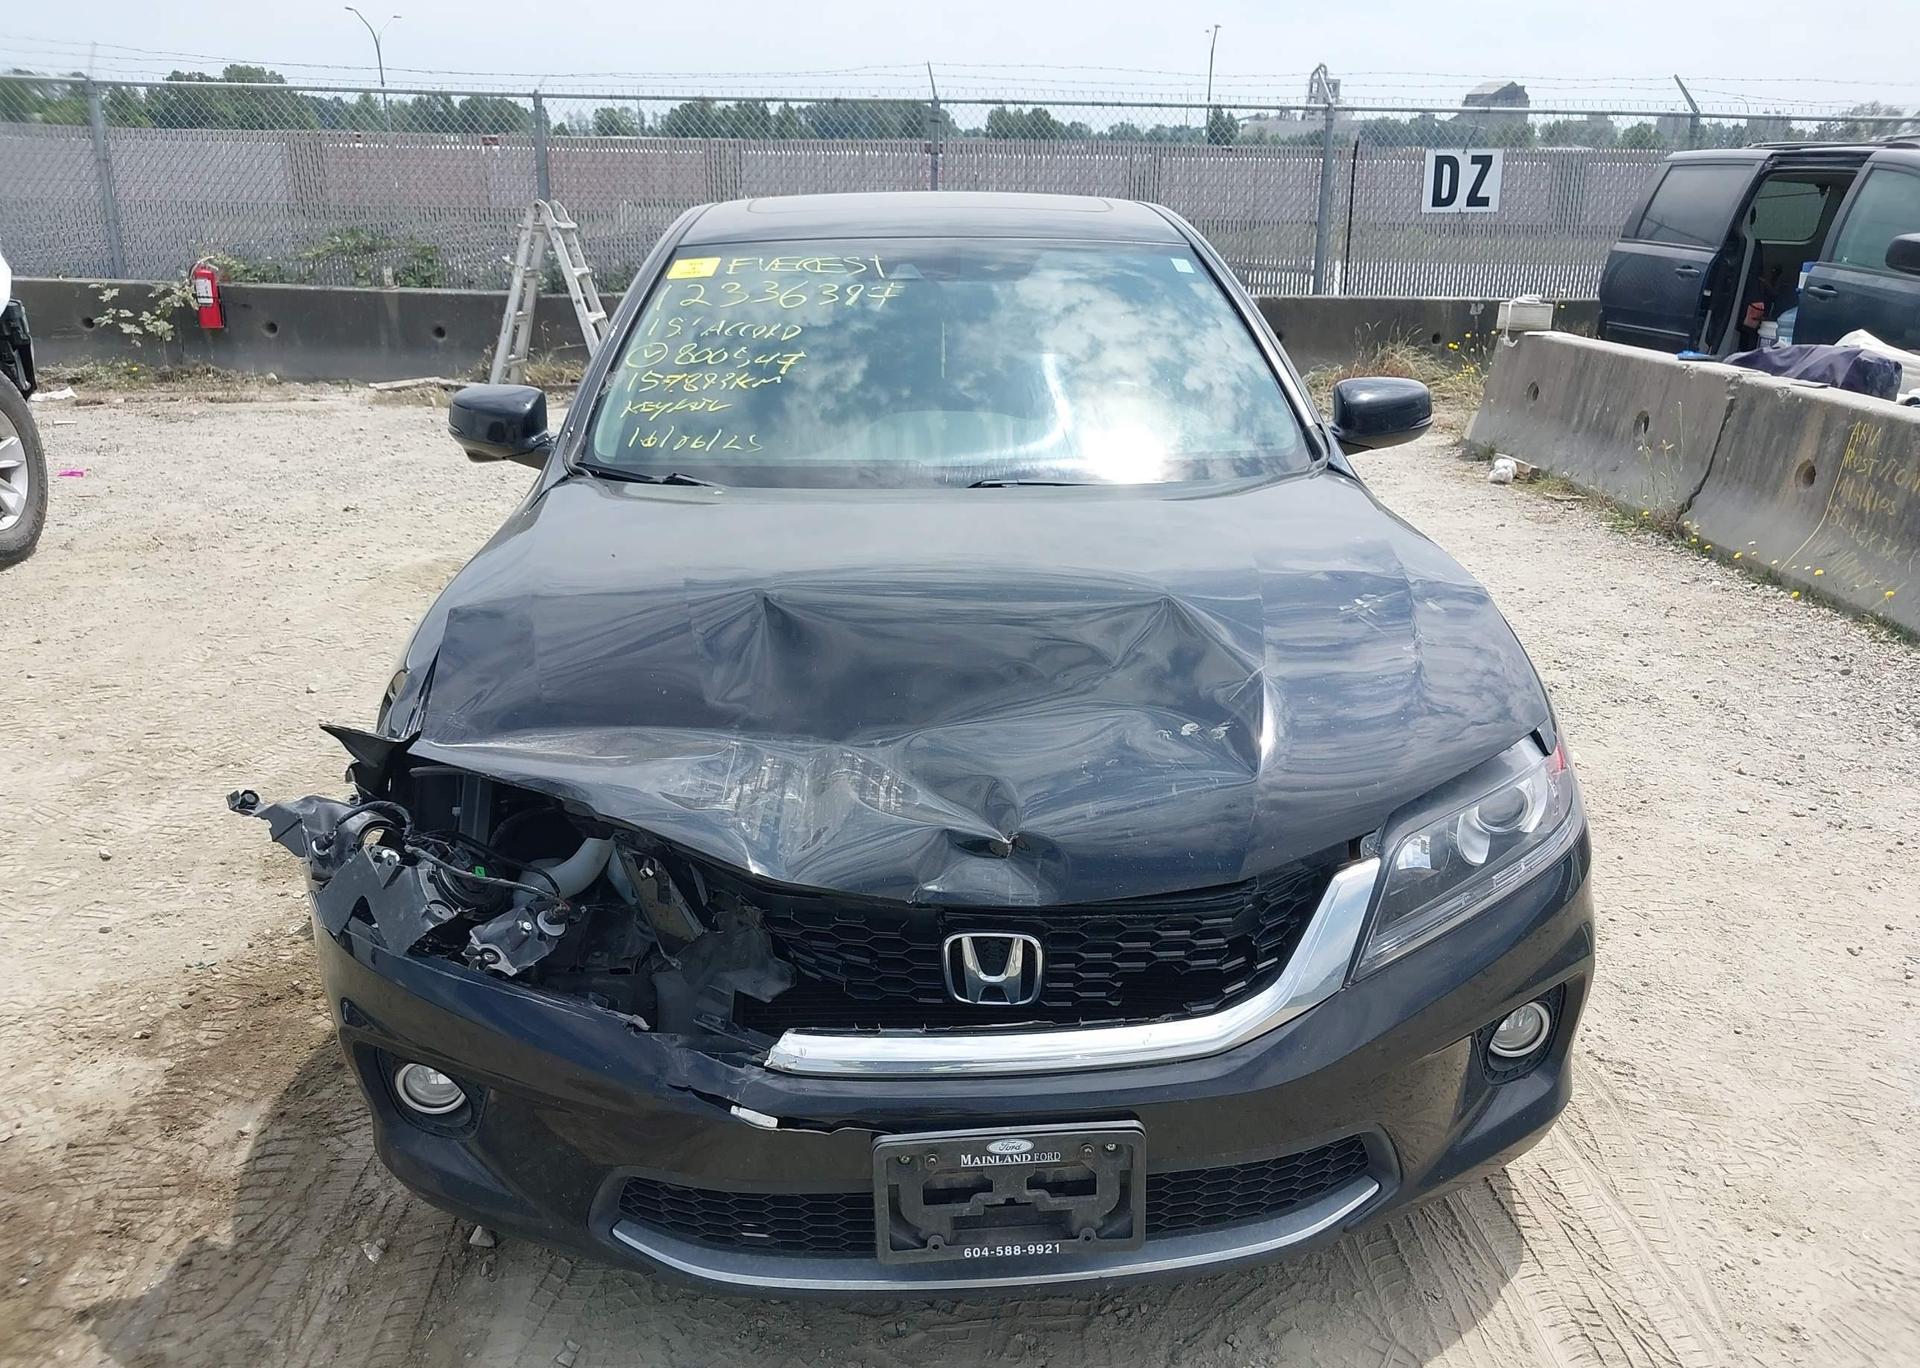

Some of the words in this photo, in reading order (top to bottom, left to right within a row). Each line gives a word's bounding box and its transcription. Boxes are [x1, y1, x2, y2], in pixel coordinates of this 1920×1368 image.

[1431, 154, 1493, 207] DZ
[700, 319, 803, 341] ACCORD
[999, 1141, 1023, 1151] Ford
[1034, 1151, 1061, 1161] FORD
[963, 1243, 1061, 1259] 604-588-9921
